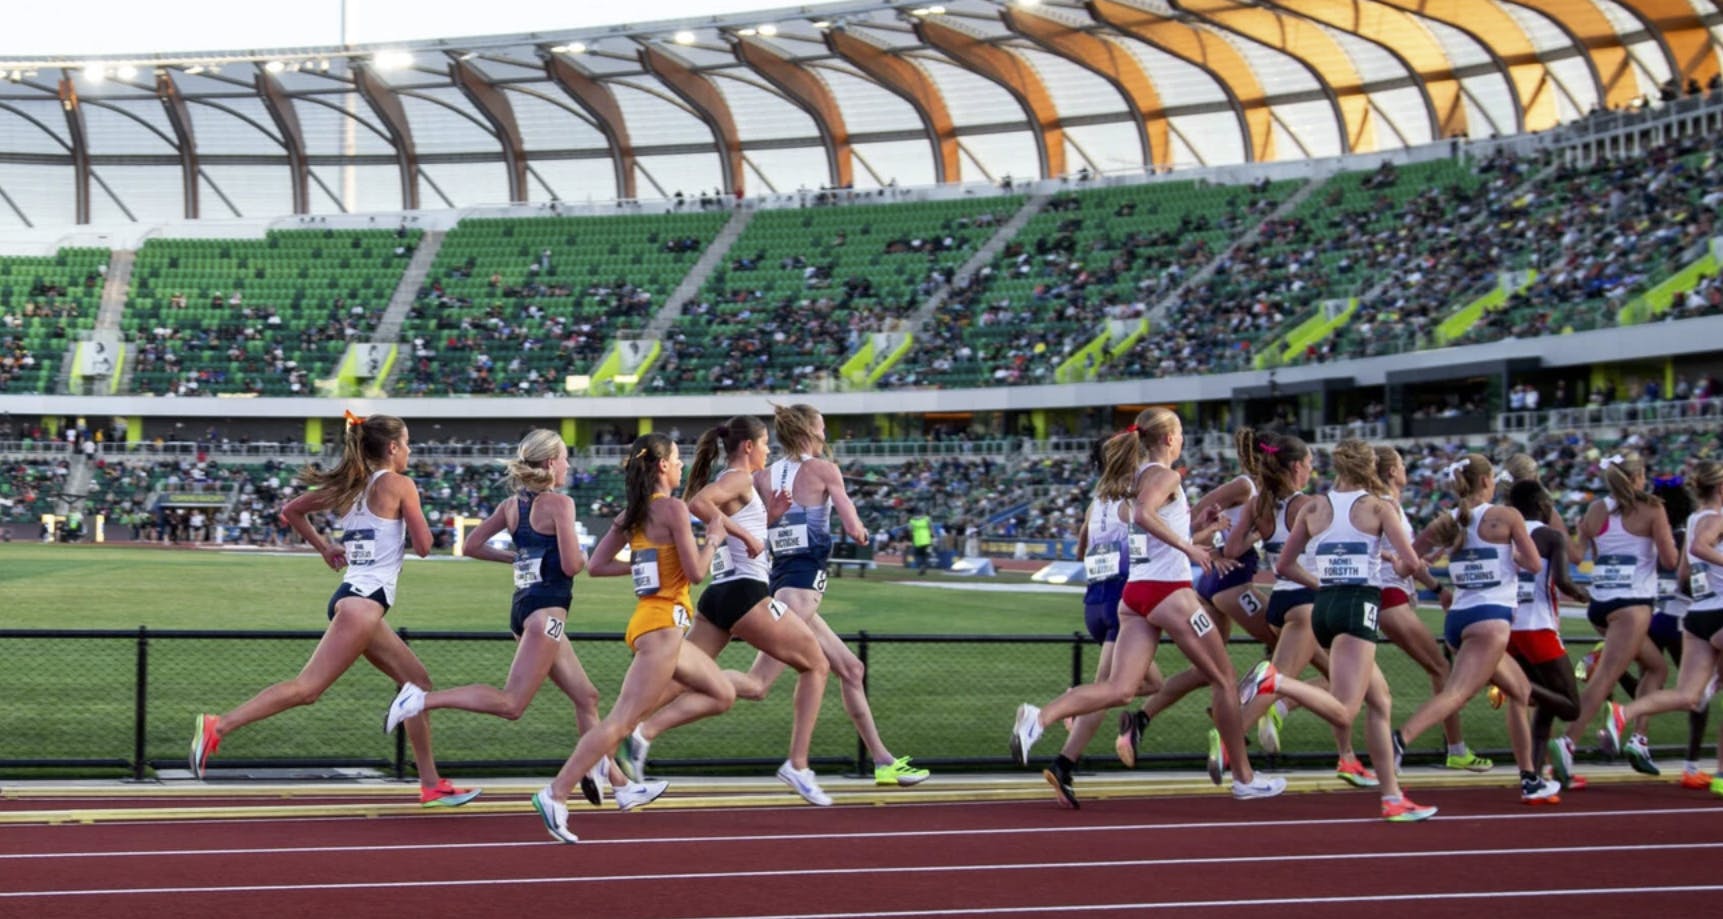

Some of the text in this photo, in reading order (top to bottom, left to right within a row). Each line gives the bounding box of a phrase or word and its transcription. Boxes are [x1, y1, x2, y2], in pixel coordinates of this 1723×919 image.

[1324, 566, 1360, 577] FORSYTH
[1455, 571, 1494, 582] HUTCHINS
[1242, 592, 1259, 613] 3
[1193, 614, 1210, 633] 10
[1367, 605, 1376, 626] 4
[547, 618, 562, 639] 20
